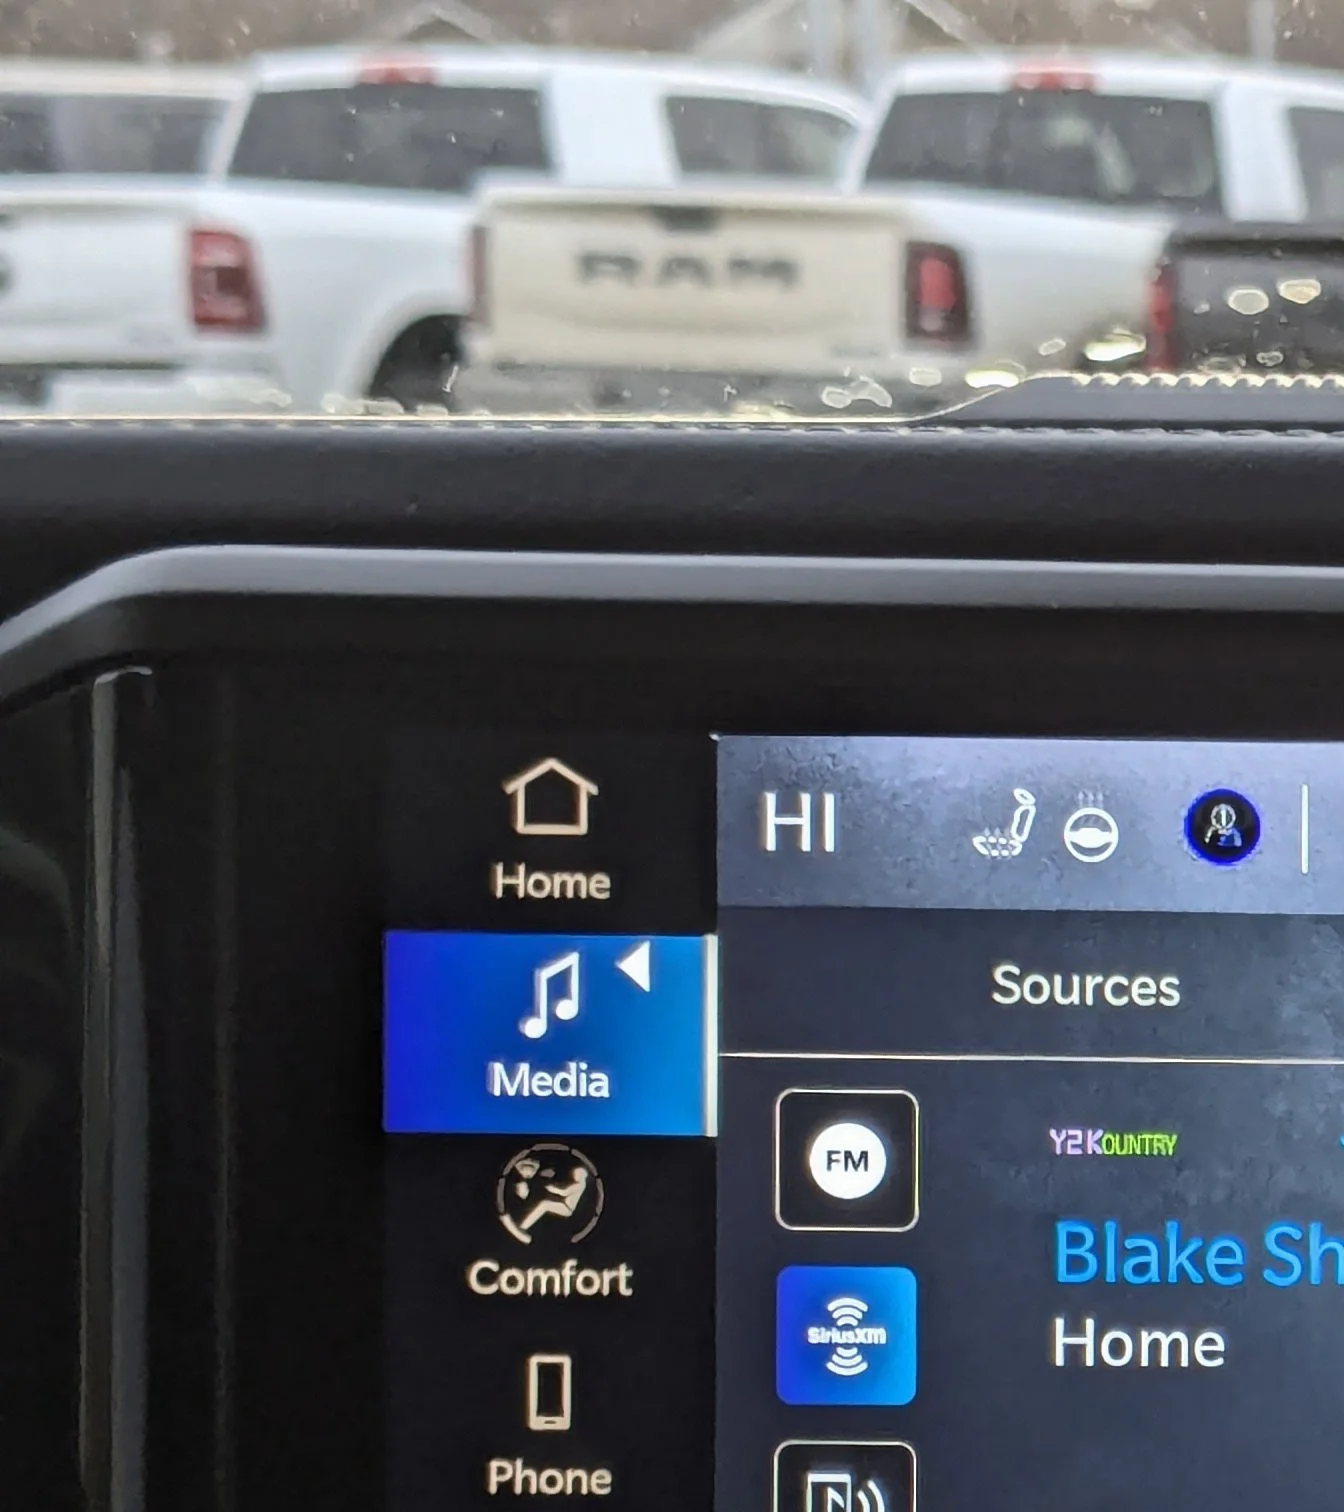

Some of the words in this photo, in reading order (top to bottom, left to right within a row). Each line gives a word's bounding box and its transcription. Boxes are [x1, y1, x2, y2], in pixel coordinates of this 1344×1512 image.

[576, 251, 798, 288] RAM
[764, 791, 836, 852] HI
[493, 863, 612, 900] Home
[991, 964, 1181, 1007] Sources
[487, 1061, 610, 1099] Media
[825, 1149, 870, 1173] FM
[1055, 1221, 1245, 1287] Blake
[467, 1259, 634, 1297] Comfort
[1052, 1318, 1226, 1367] Home
[487, 1459, 613, 1495] Phone
